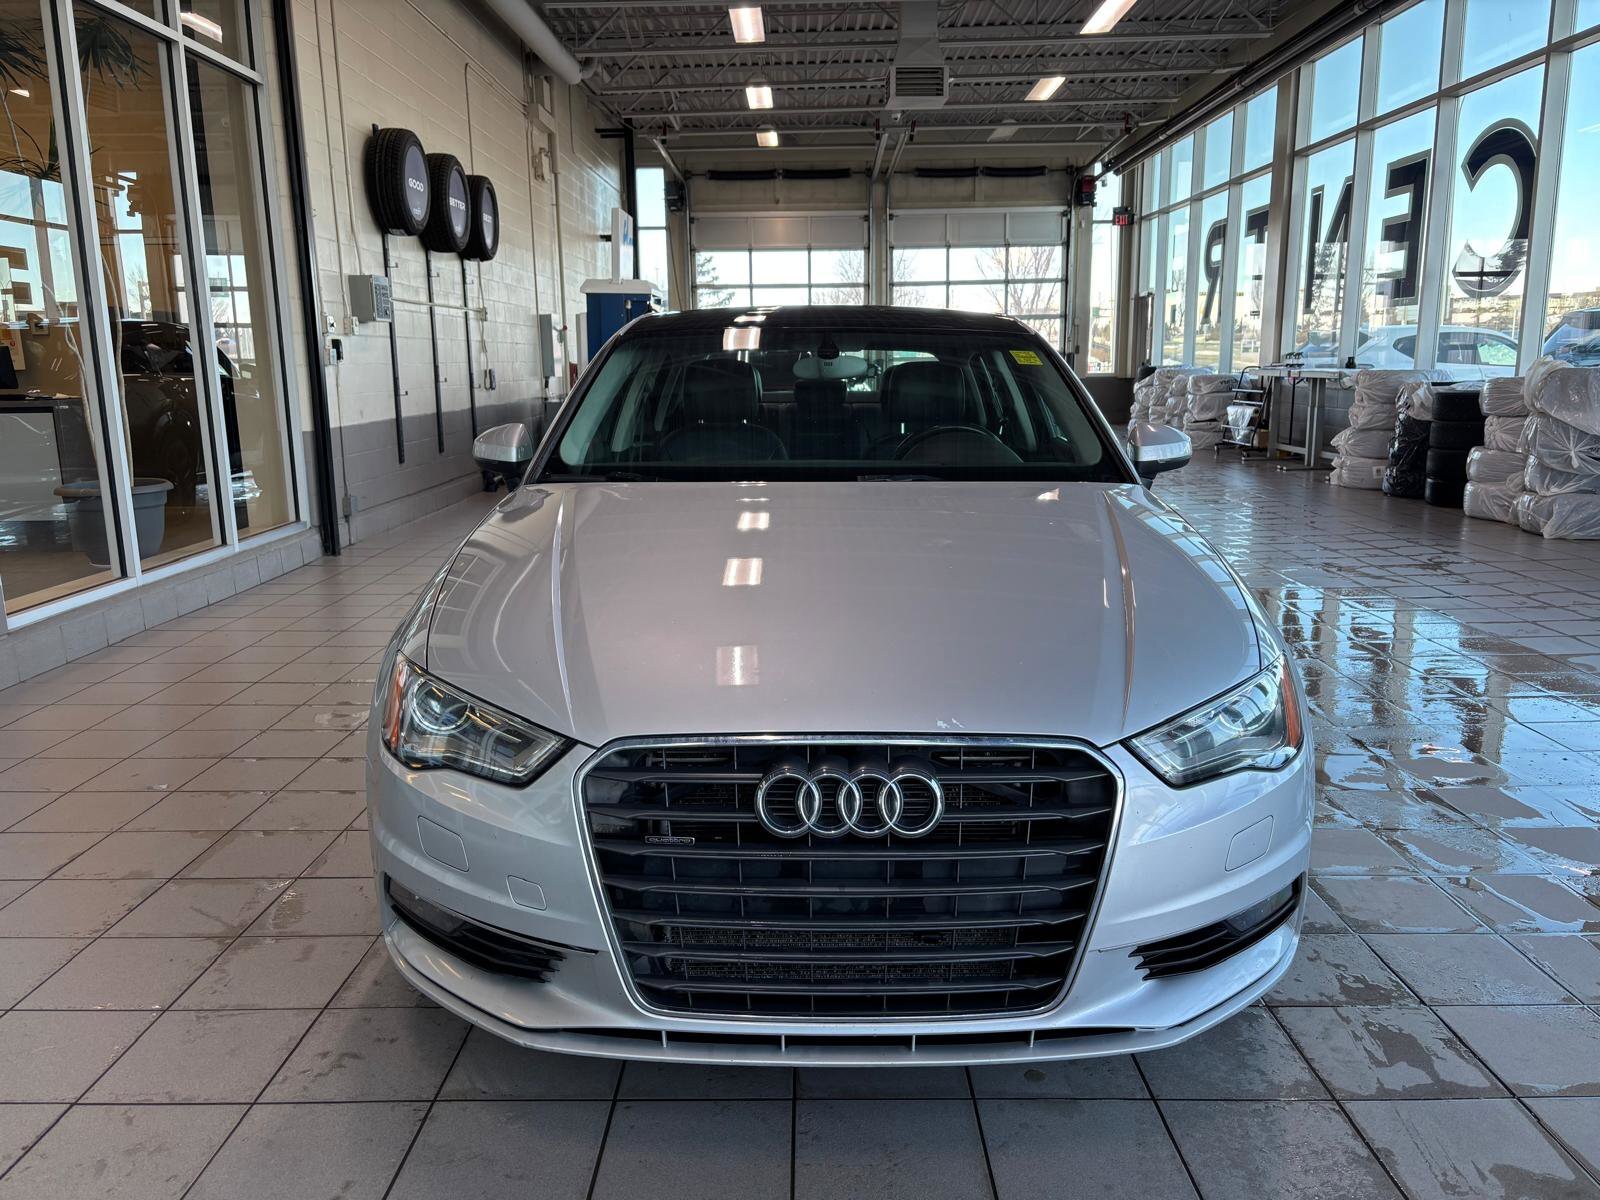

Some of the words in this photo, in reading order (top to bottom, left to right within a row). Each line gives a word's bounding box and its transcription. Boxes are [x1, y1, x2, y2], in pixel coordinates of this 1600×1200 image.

[408, 178, 424, 191] GOOD
[449, 197, 465, 210] BETTER
[1115, 214, 1128, 225] EXIT
